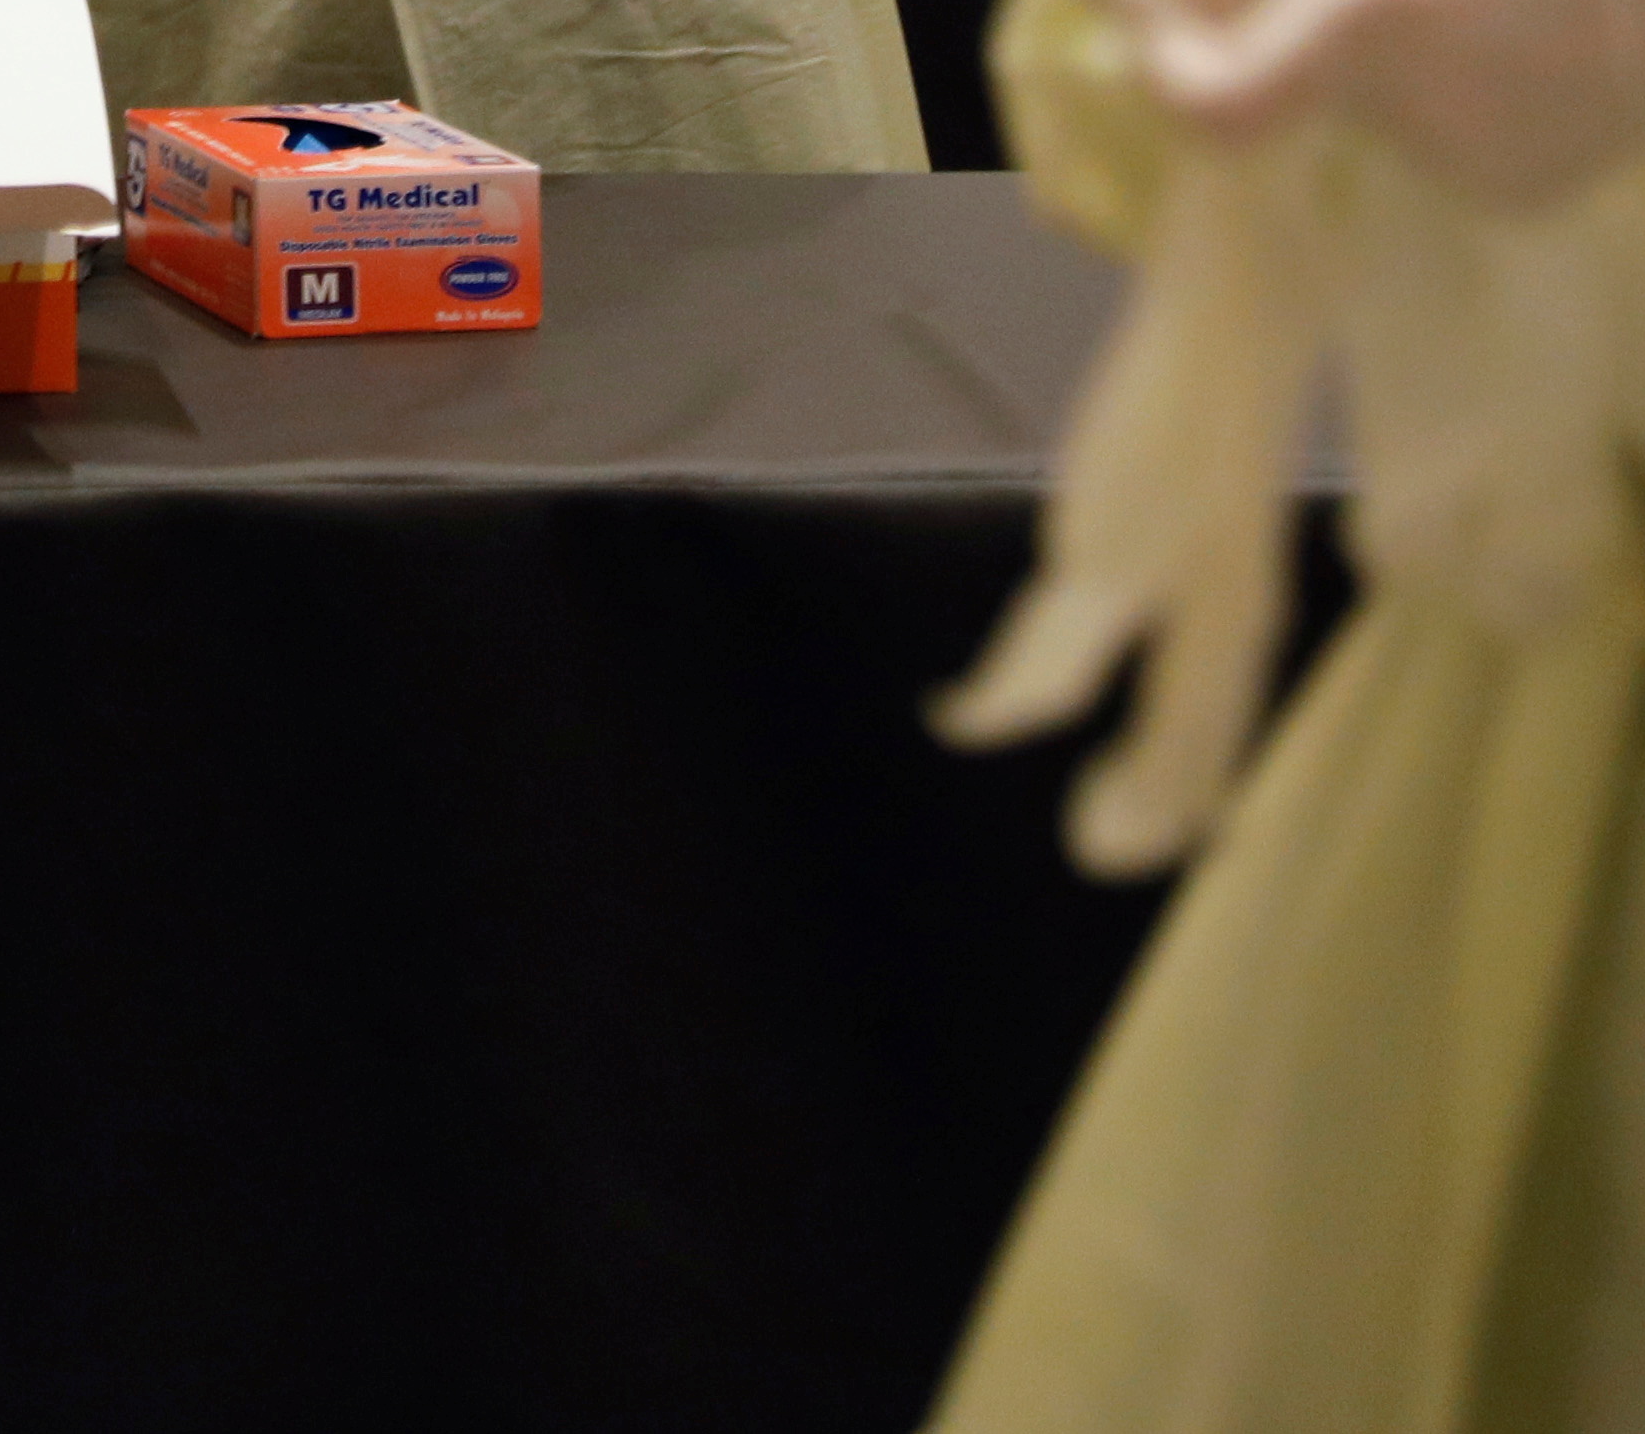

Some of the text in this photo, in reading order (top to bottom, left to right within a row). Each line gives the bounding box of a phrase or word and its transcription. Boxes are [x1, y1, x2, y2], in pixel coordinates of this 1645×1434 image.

[308, 182, 479, 212] TG Medical
[301, 272, 340, 305] M
